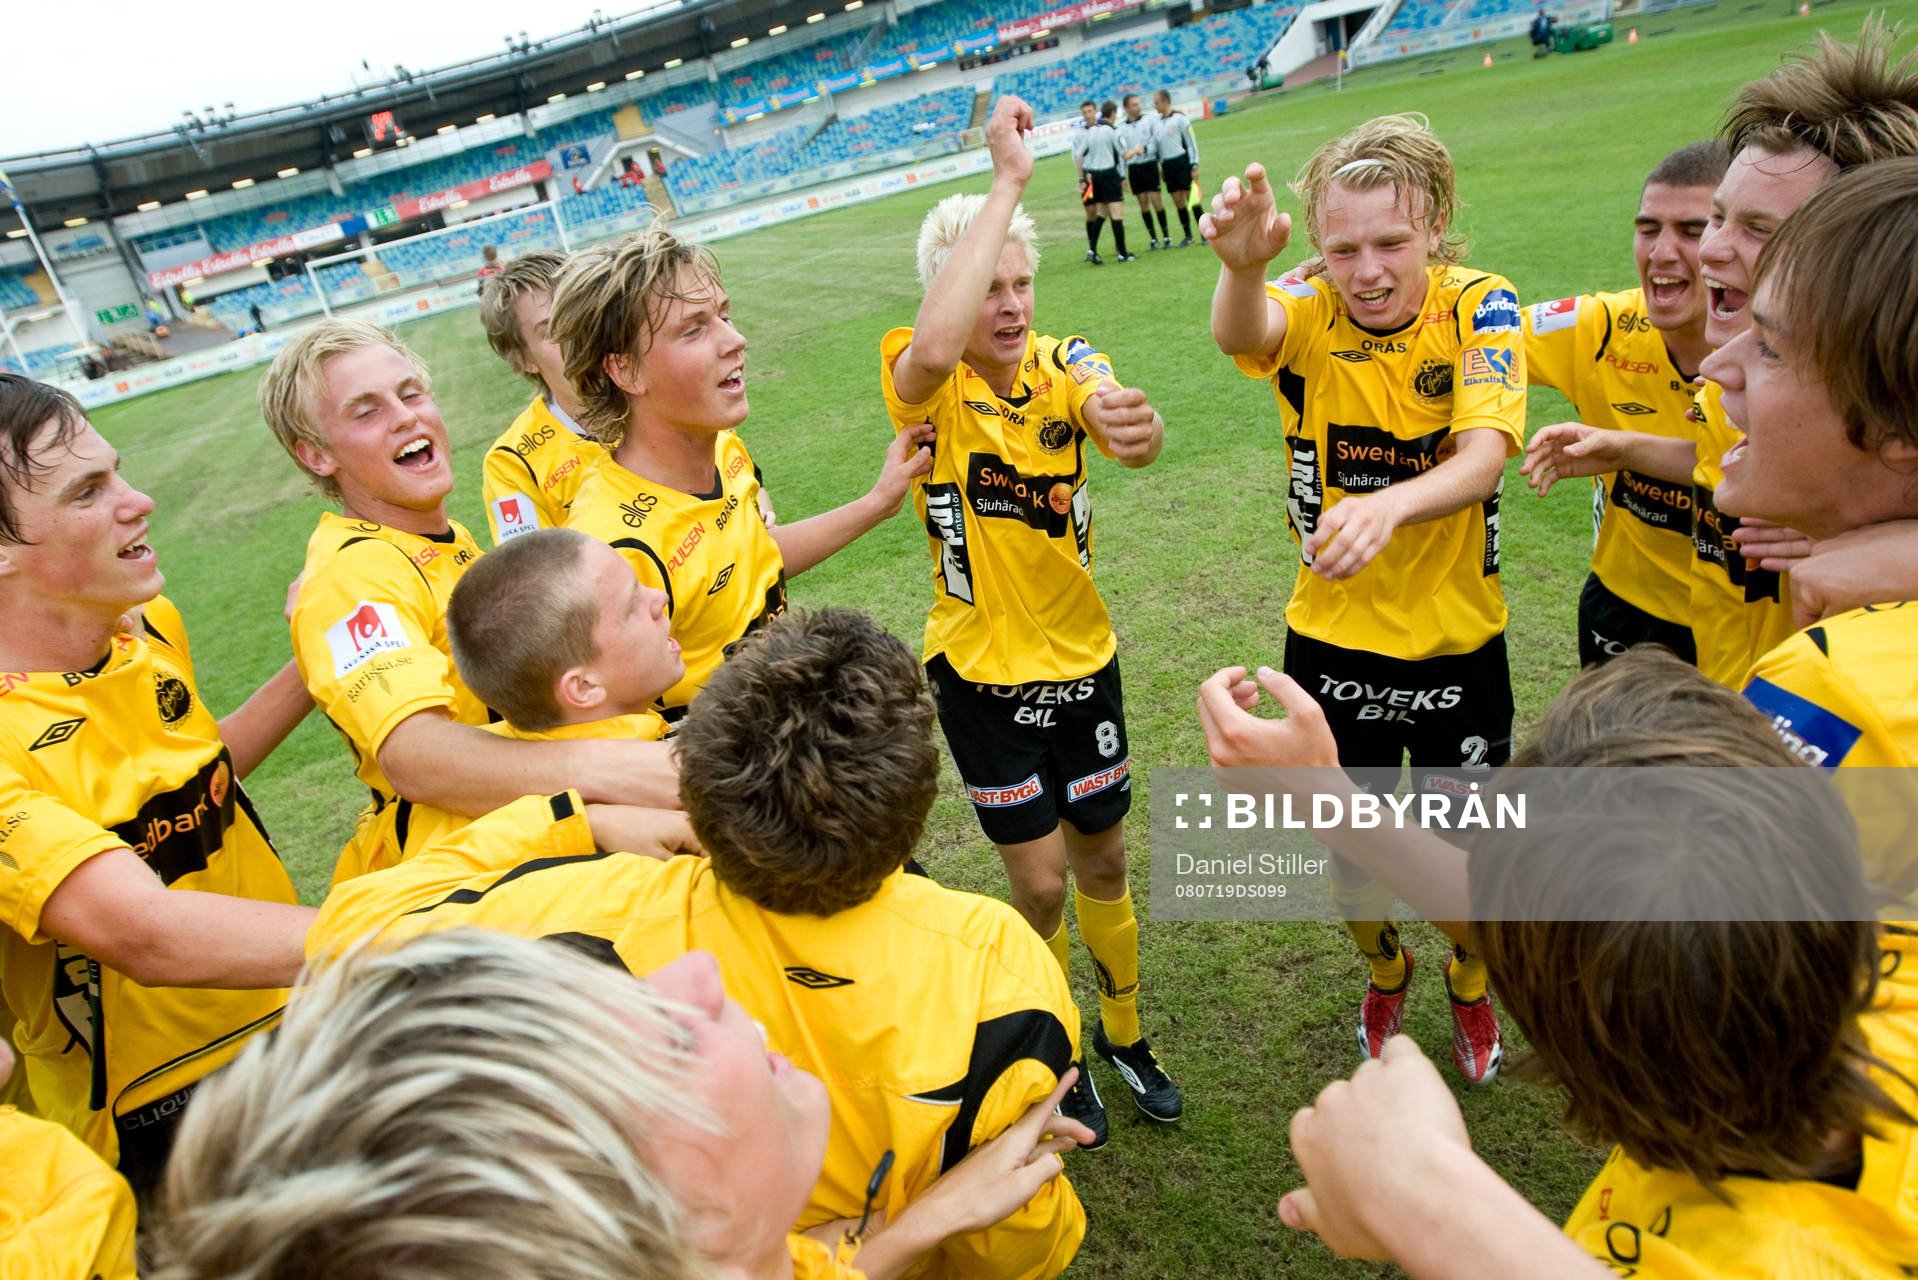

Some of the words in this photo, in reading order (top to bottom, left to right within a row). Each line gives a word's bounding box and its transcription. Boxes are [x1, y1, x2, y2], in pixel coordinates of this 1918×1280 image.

[516, 424, 556, 456] ellos
[1623, 469, 1692, 510] Swedb
[667, 520, 706, 577] PULSEN
[1319, 674, 1464, 712] TOVEKS
[1013, 706, 1057, 728] BIL
[1356, 704, 1416, 725] BIL
[1094, 720, 1121, 758] 8
[1460, 735, 1491, 773] 2
[123, 1086, 197, 1130] CLIQU
